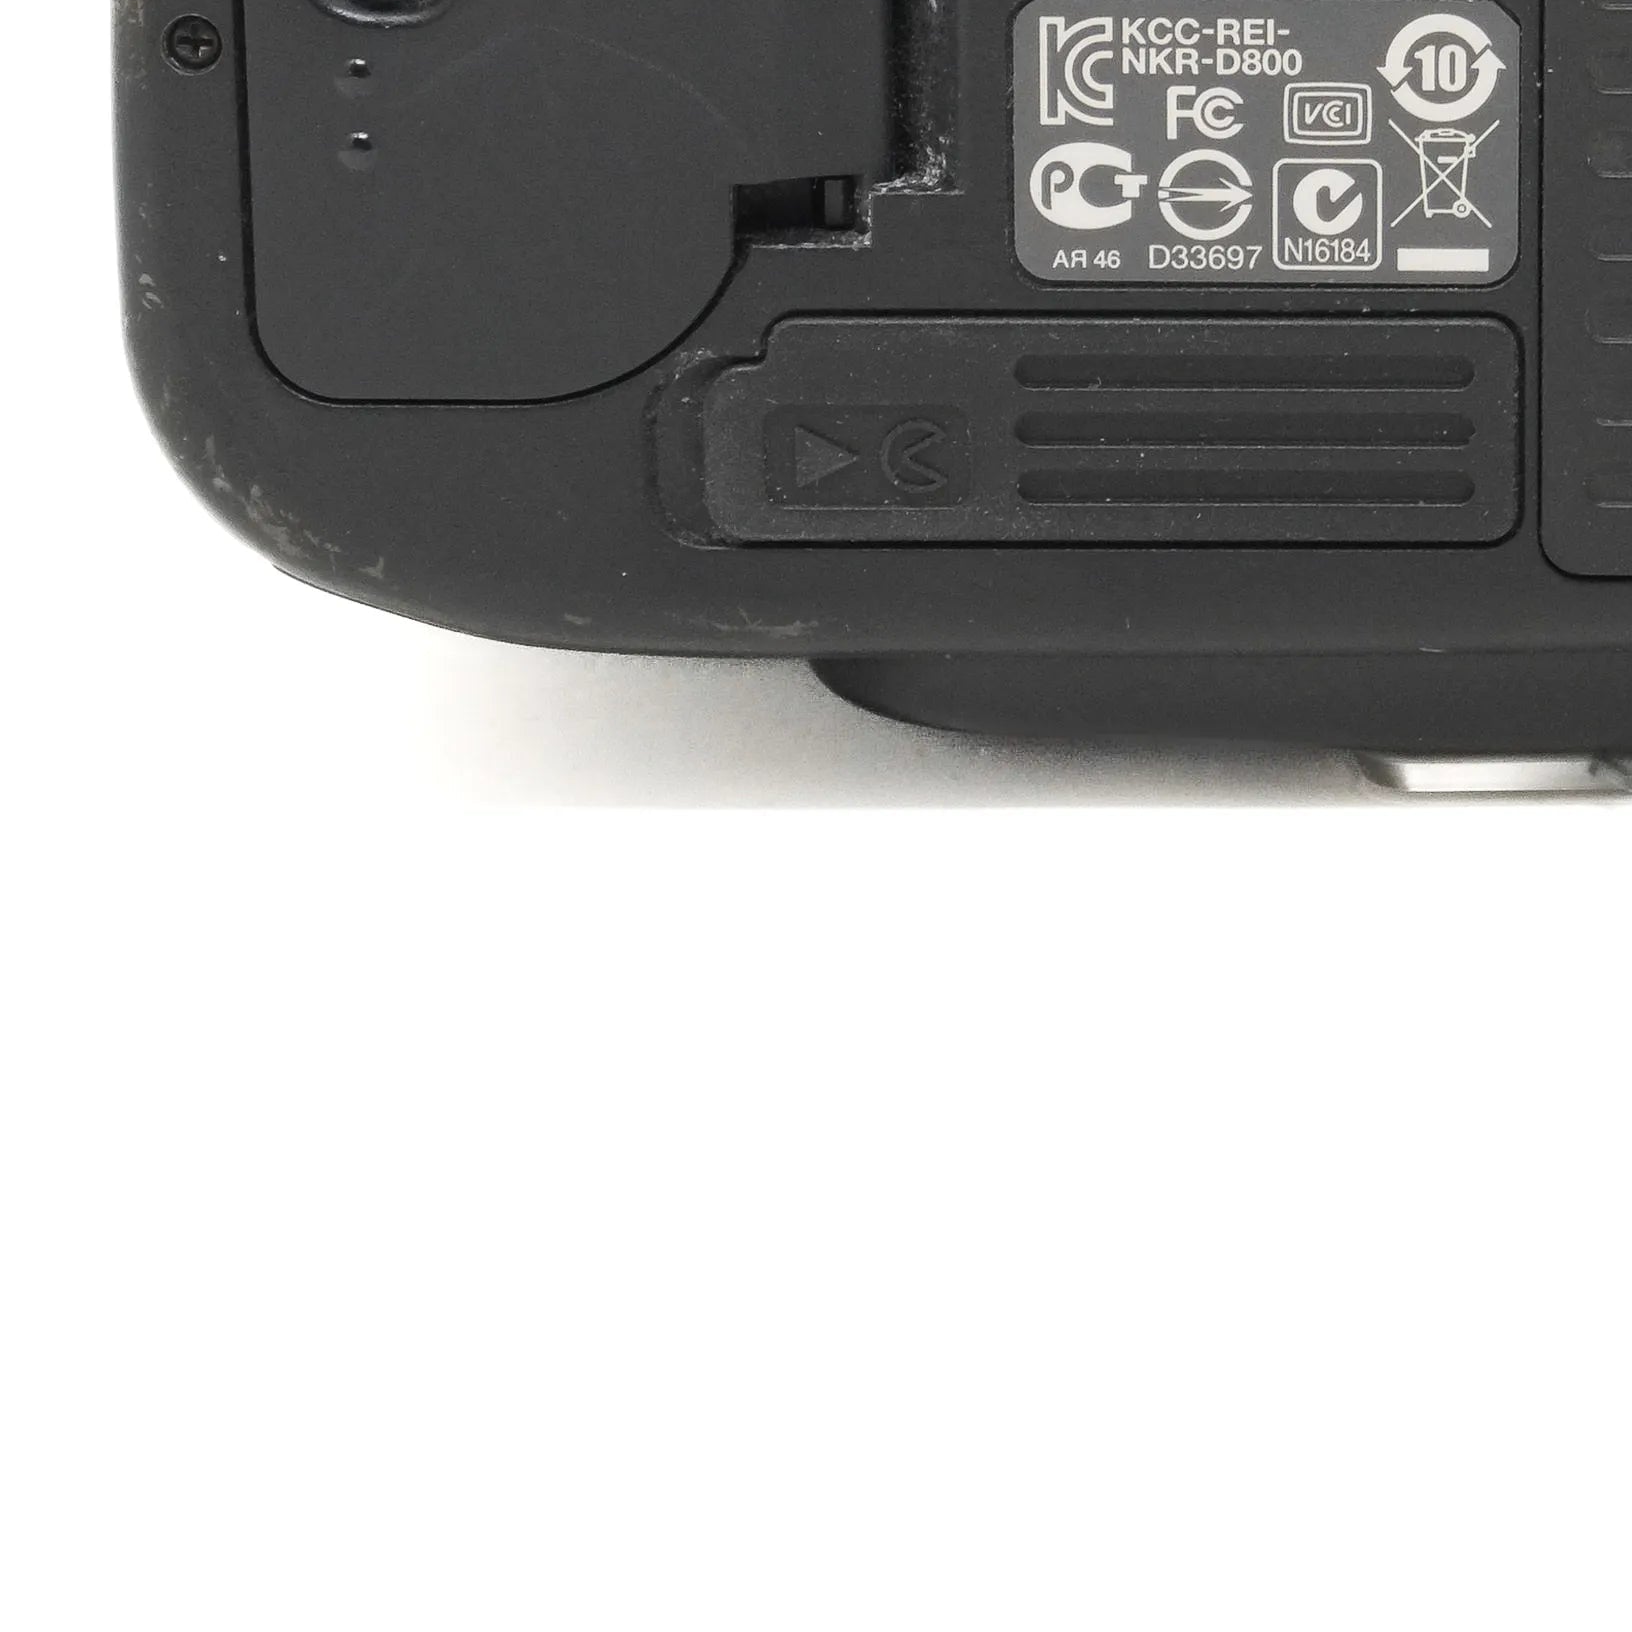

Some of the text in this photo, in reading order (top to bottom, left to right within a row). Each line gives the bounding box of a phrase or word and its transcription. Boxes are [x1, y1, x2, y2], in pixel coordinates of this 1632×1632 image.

[1121, 17, 1291, 45] KCC-REI-
[1121, 47, 1303, 77] NKR-D800
[1413, 43, 1469, 93] 10
[1093, 249, 1121, 269] 46
[1148, 245, 1263, 270] D33697
[1284, 237, 1371, 264] N16184
